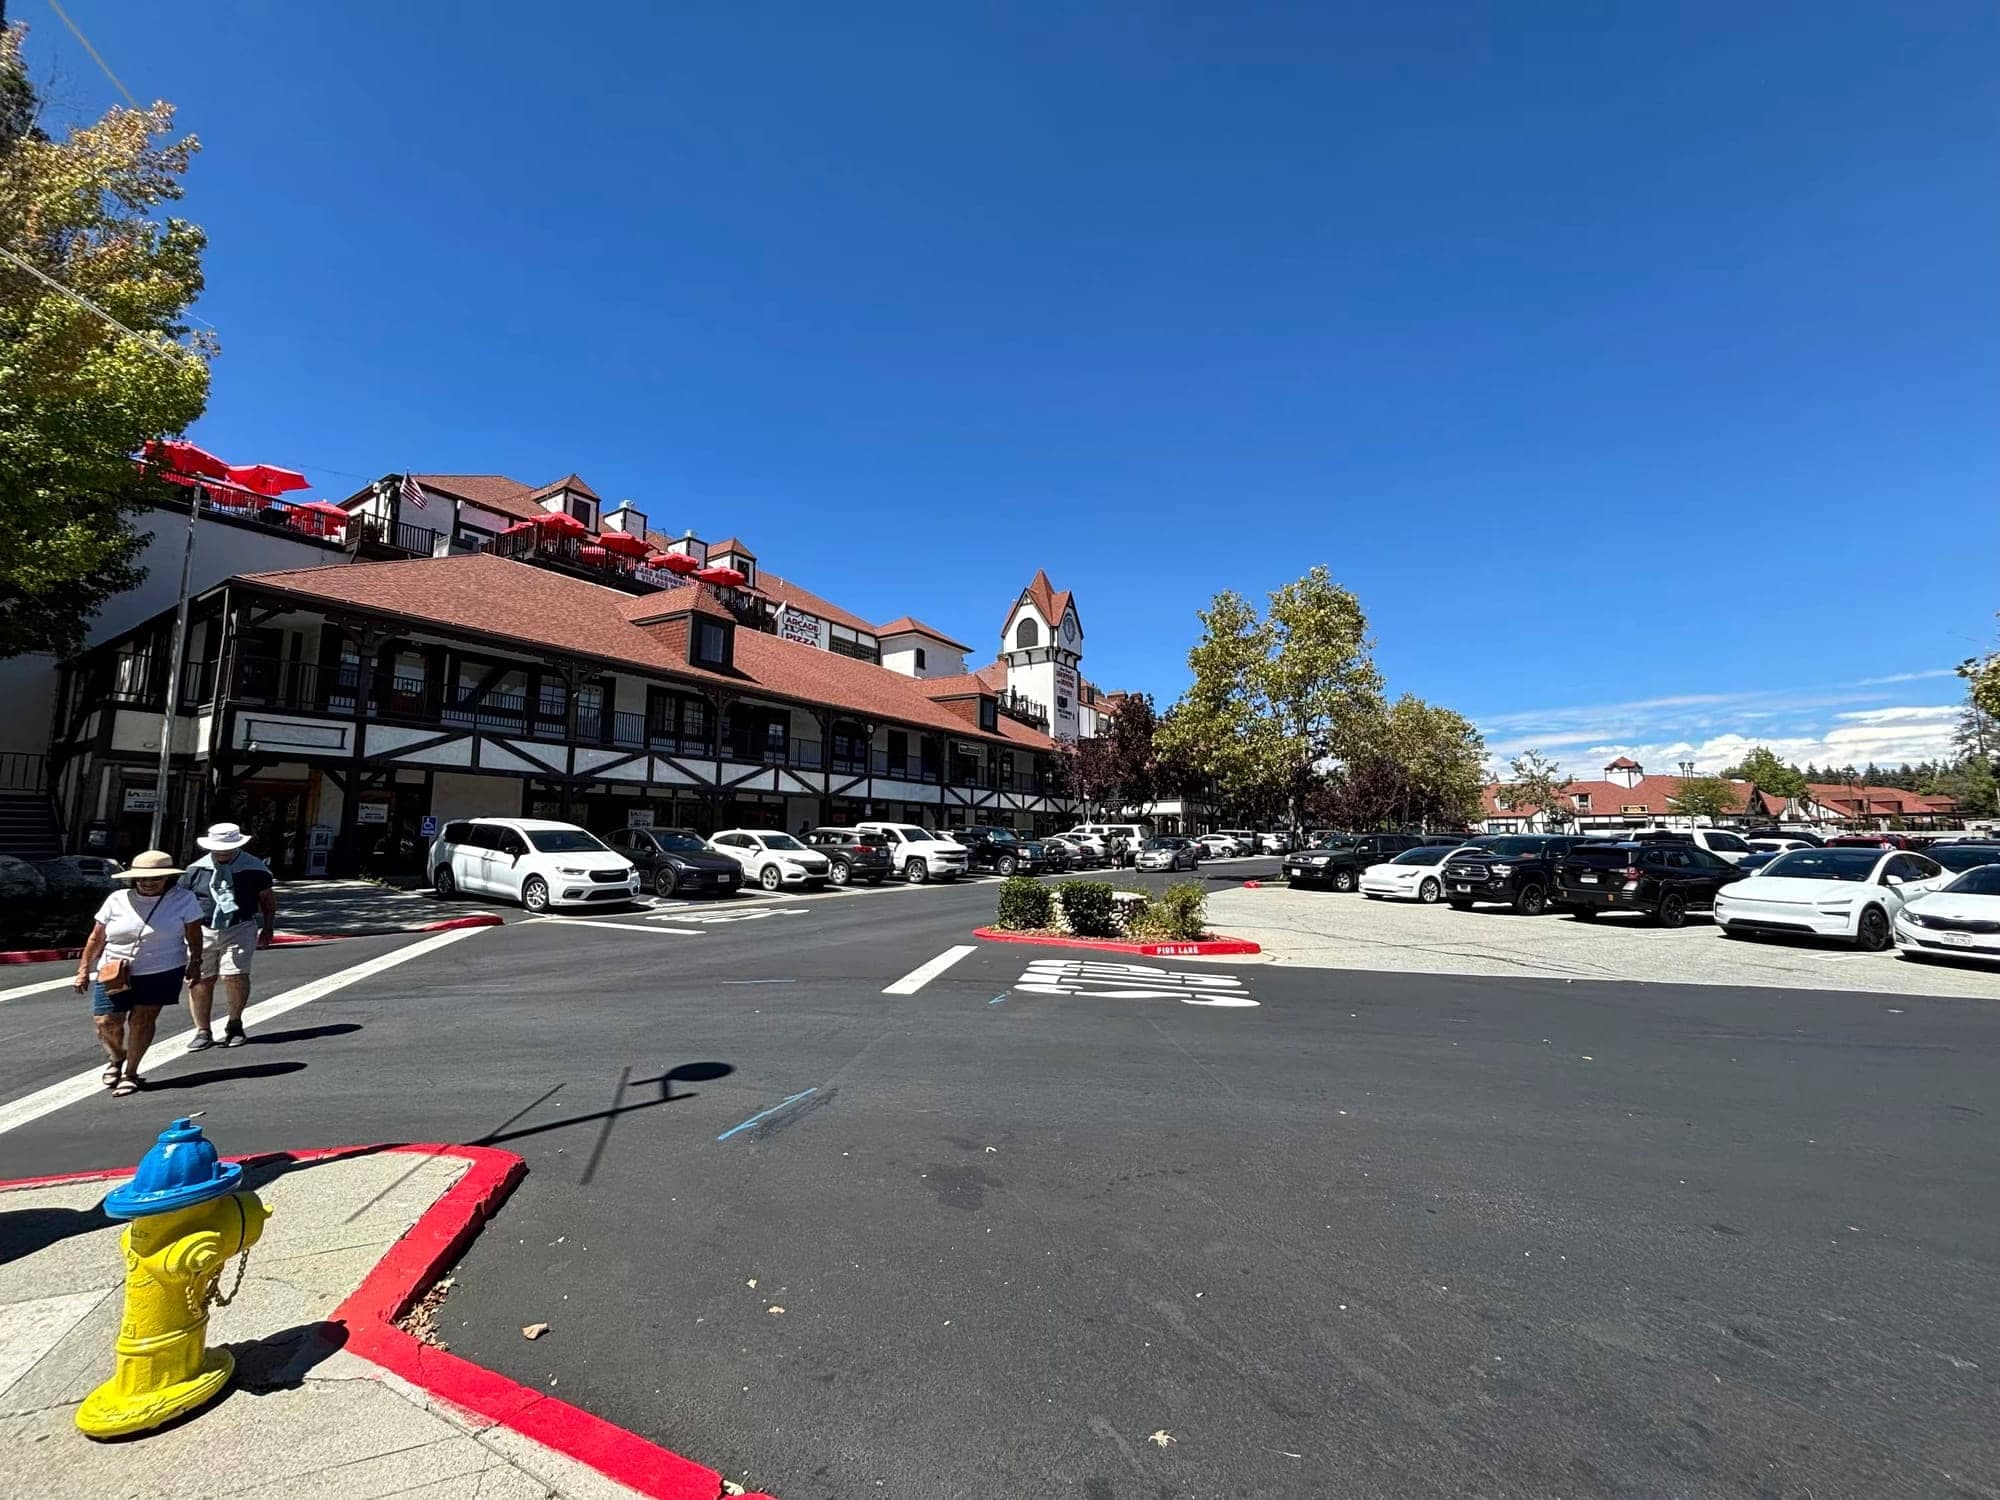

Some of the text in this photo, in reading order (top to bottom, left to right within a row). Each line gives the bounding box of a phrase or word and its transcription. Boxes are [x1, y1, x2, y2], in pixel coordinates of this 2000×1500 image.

[786, 616, 819, 633] ARCADE
[785, 632, 817, 648] PIZZA
[1156, 944, 1199, 955] FIRE LANE
